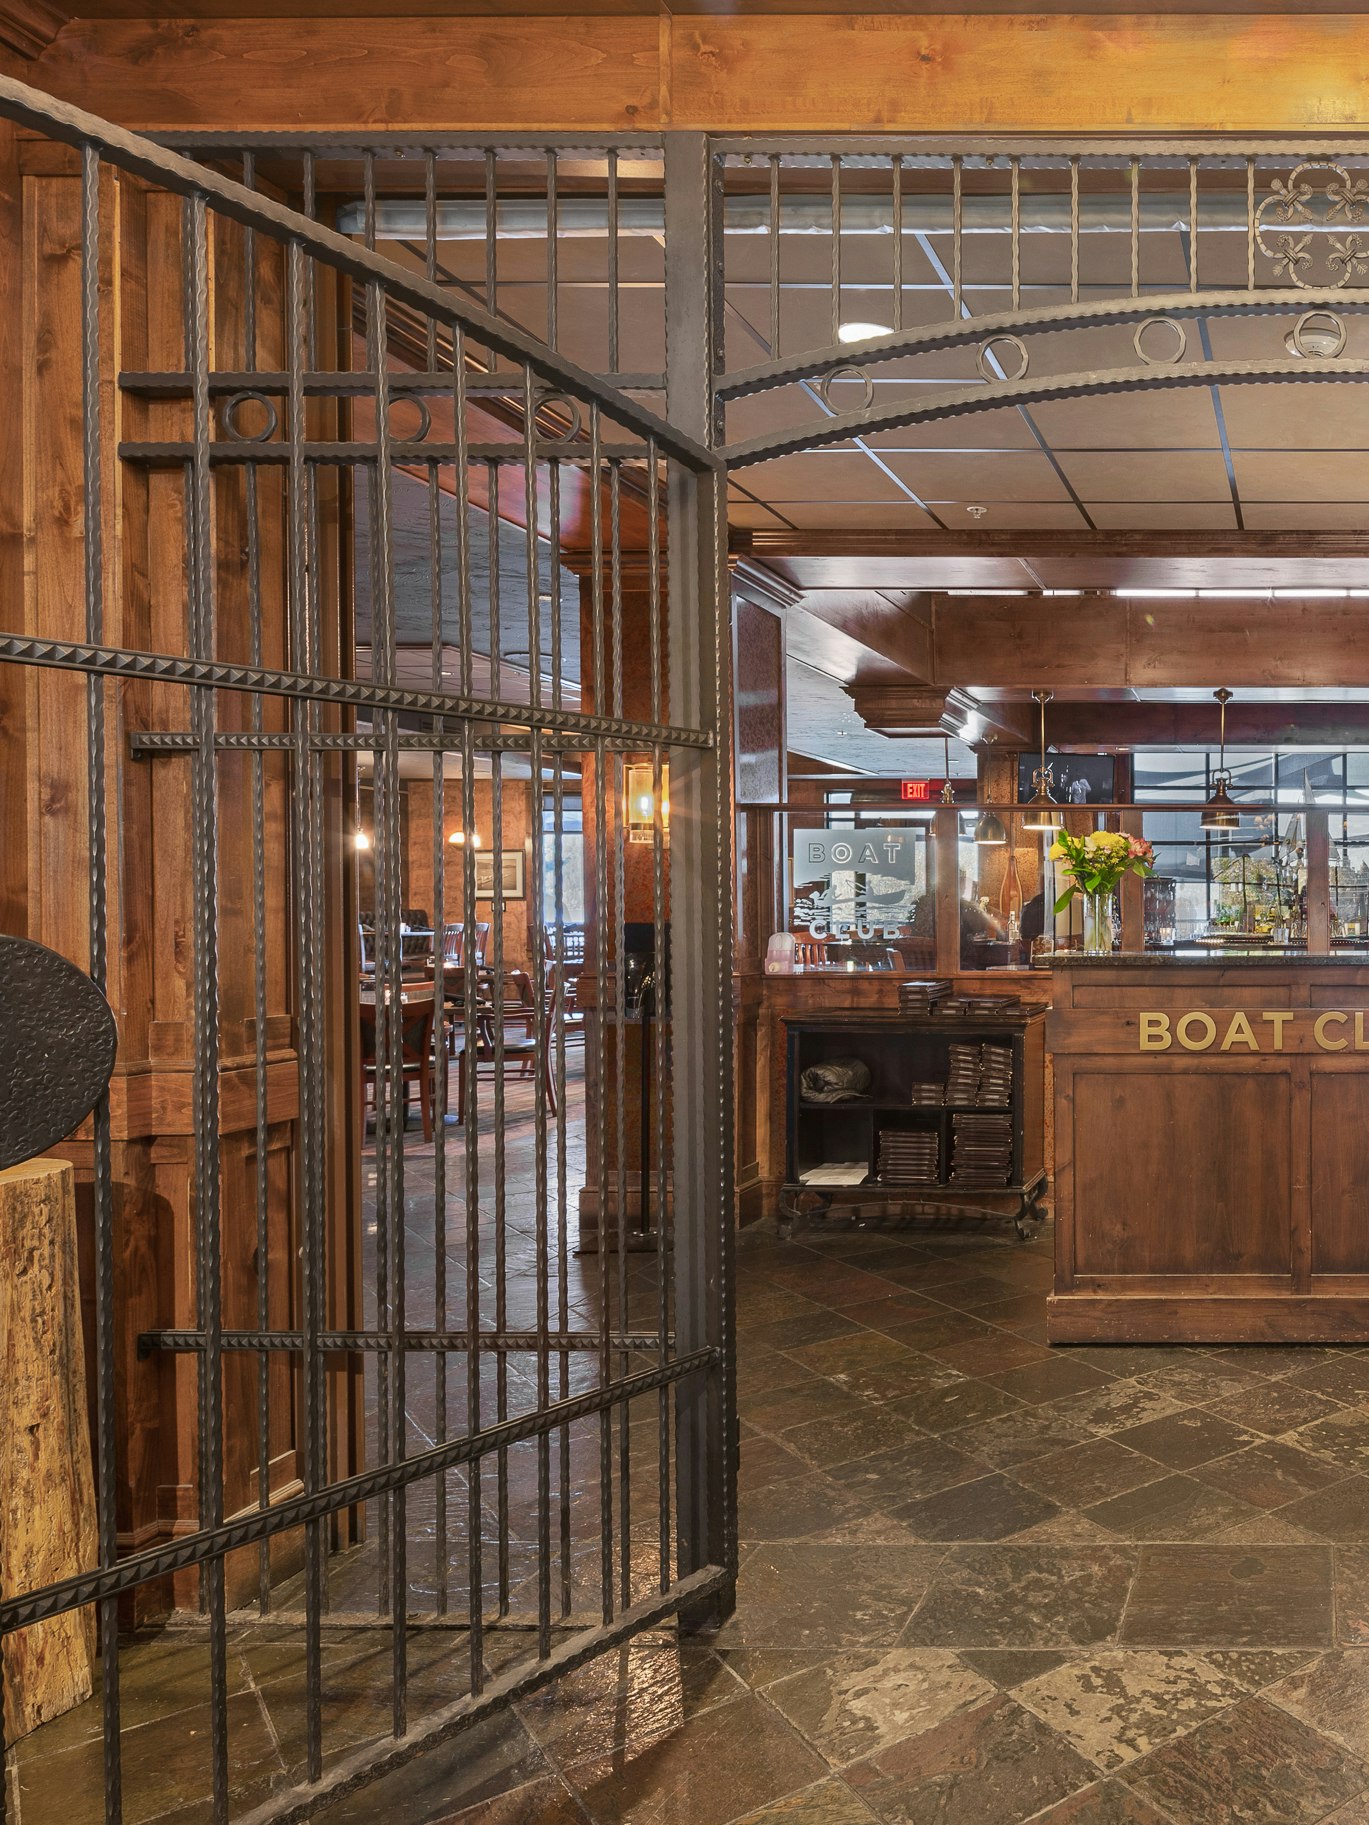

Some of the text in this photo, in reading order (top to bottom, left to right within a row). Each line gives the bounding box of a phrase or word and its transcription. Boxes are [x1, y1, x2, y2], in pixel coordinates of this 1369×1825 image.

[907, 783, 926, 798] EXIT
[808, 842, 901, 864] BOAT
[808, 919, 901, 940] CLUB
[1138, 1011, 1294, 1051] BOAT
